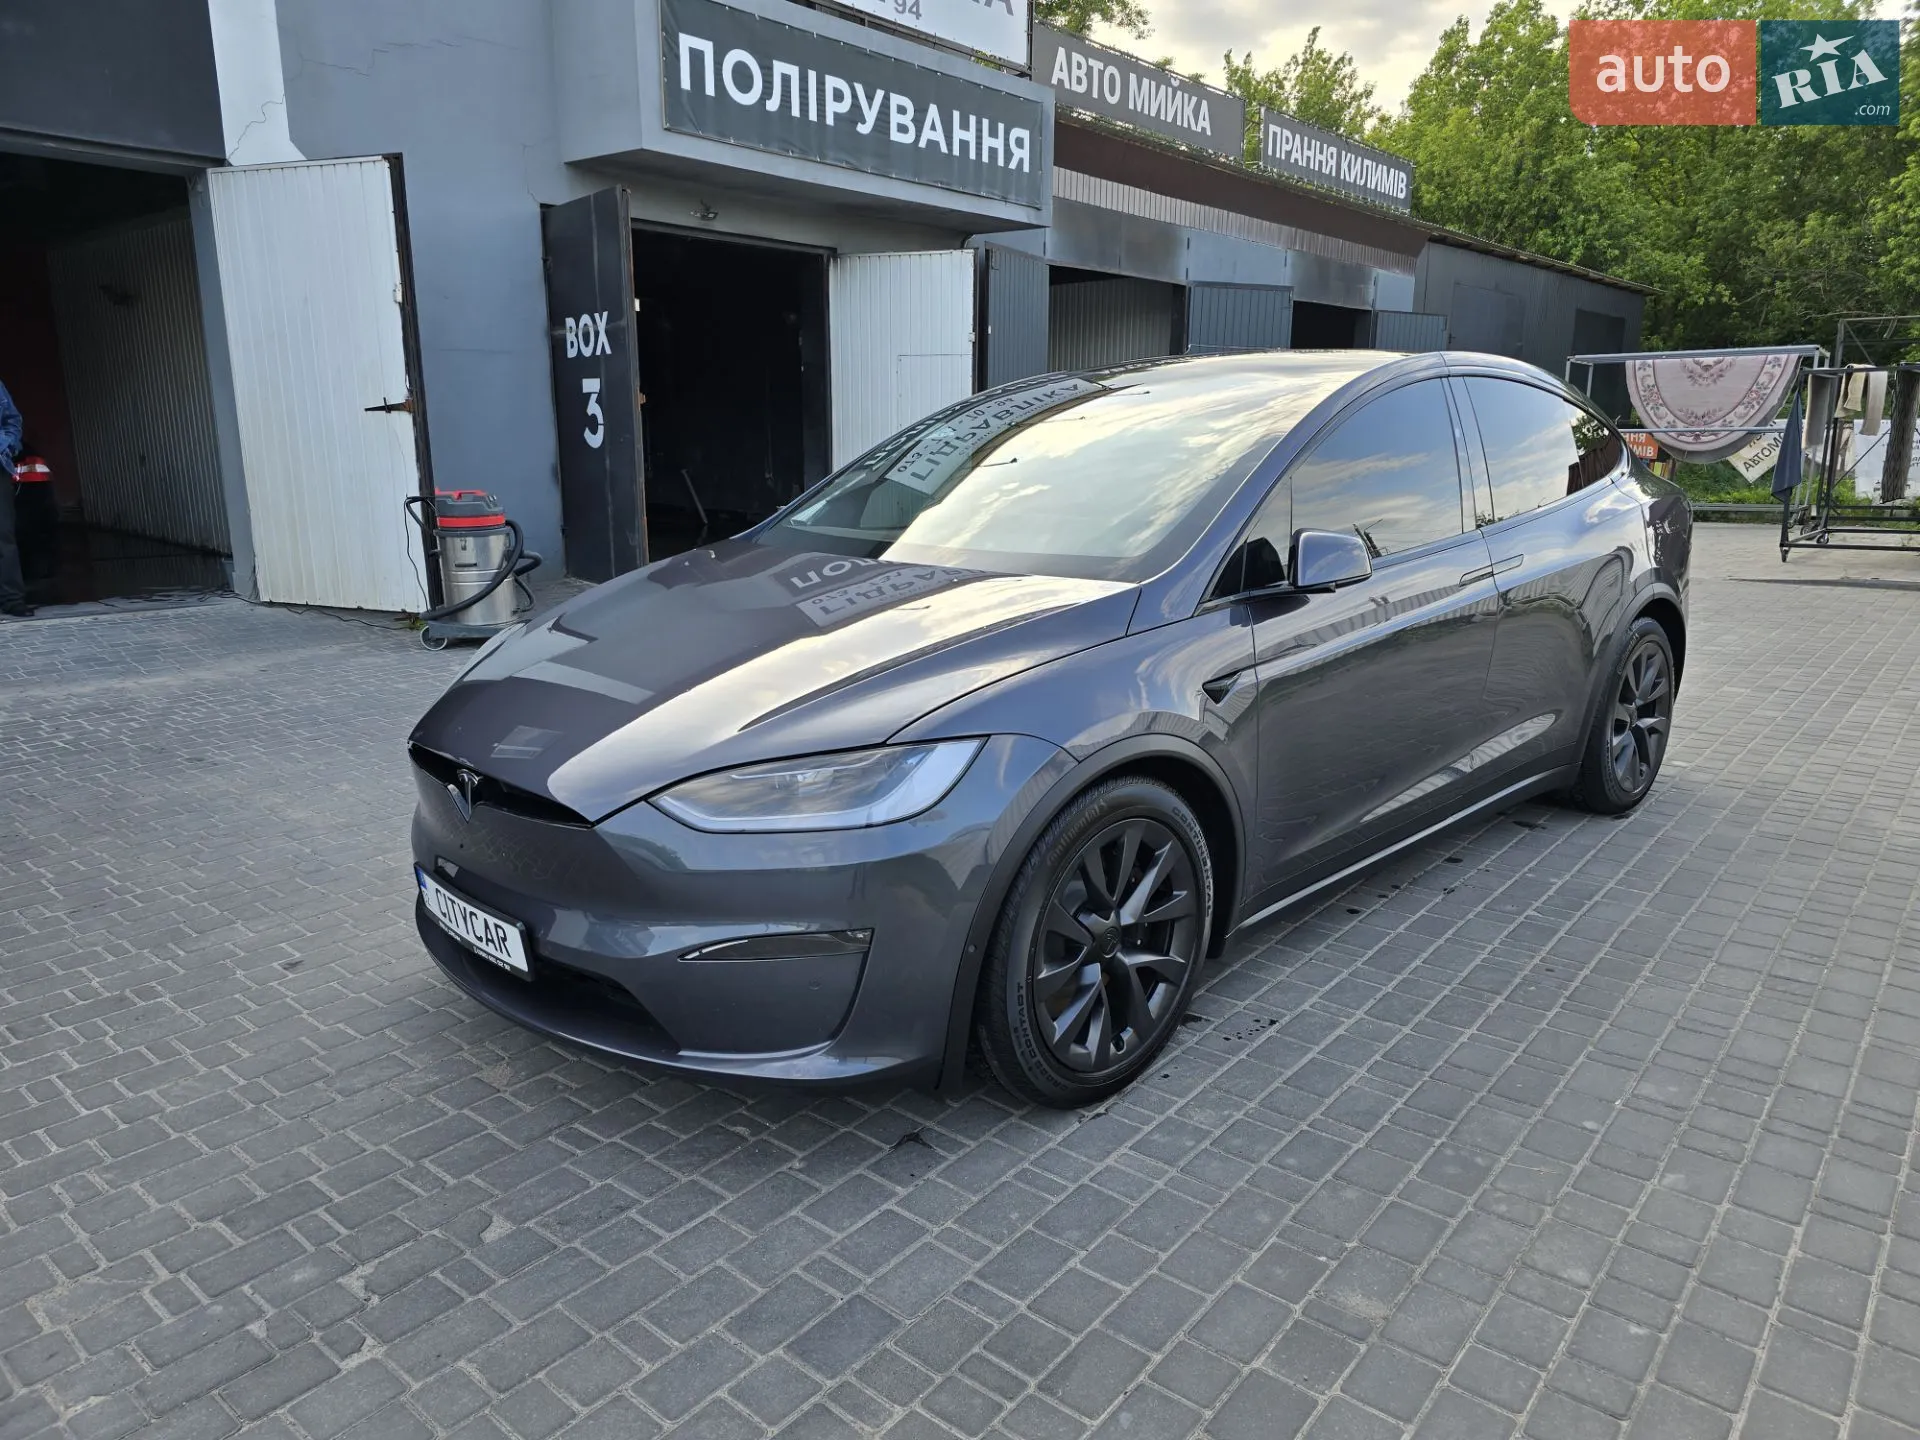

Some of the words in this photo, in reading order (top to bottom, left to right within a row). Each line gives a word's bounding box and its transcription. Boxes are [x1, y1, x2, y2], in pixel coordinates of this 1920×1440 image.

[678, 32, 1031, 173] ПОЛІРУВАННЯ
[1051, 46, 1121, 104] АВТО
[1128, 72, 1212, 137] МИЙКА
[1267, 123, 1337, 176] ПРАННЯ
[1340, 150, 1408, 200] КИЛИМІВ
[565, 310, 612, 359] BOX
[582, 378, 605, 449] 3
[1629, 444, 1654, 457] МІВ
[435, 888, 513, 959] CITYCAR
